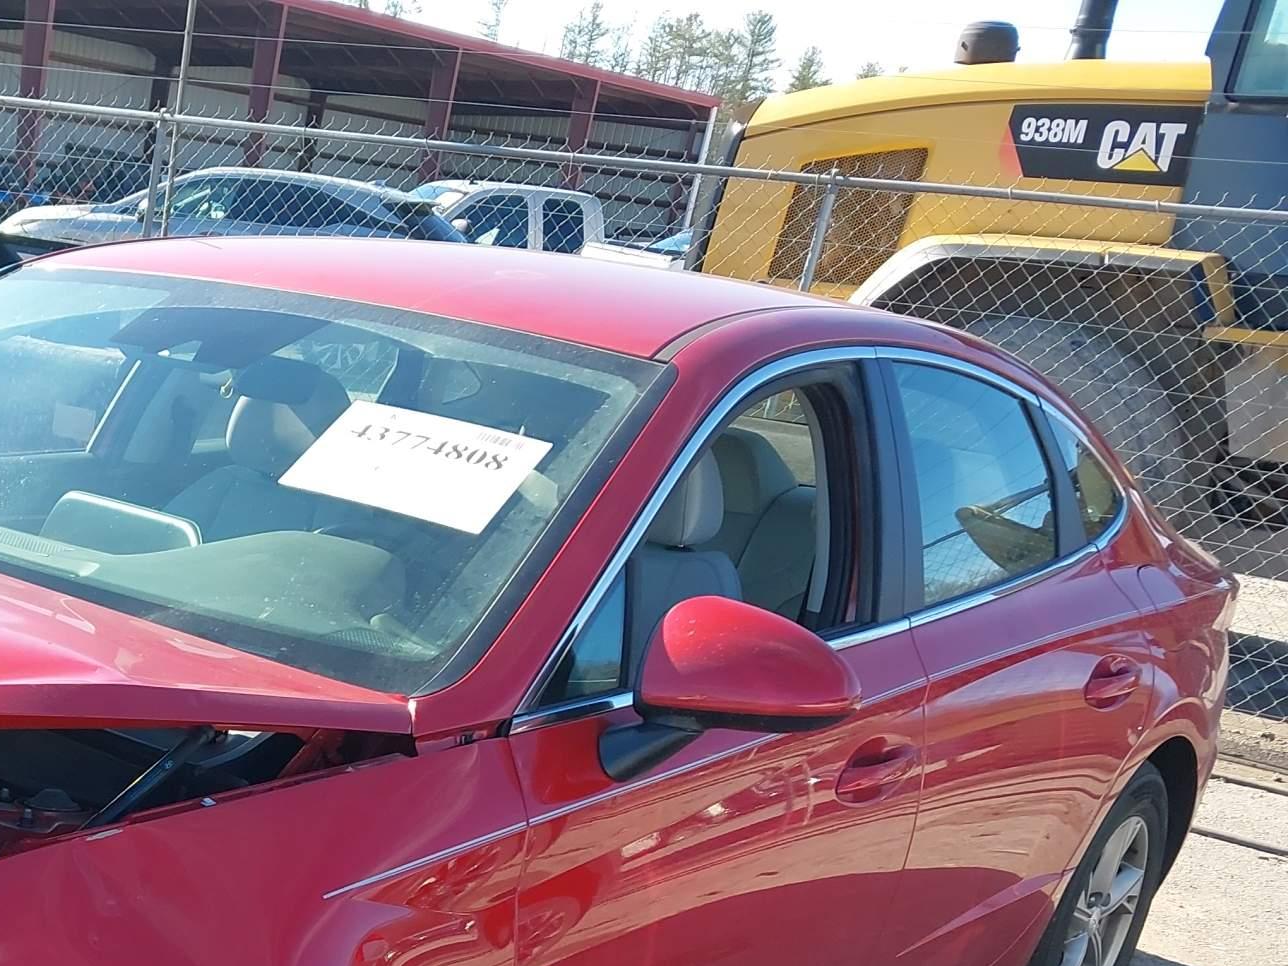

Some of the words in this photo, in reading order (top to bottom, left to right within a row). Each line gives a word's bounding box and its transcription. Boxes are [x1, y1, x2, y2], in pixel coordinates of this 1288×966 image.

[1020, 117, 1088, 144] 938M
[1097, 121, 1188, 173] CAT
[350, 424, 509, 471] 43774808
